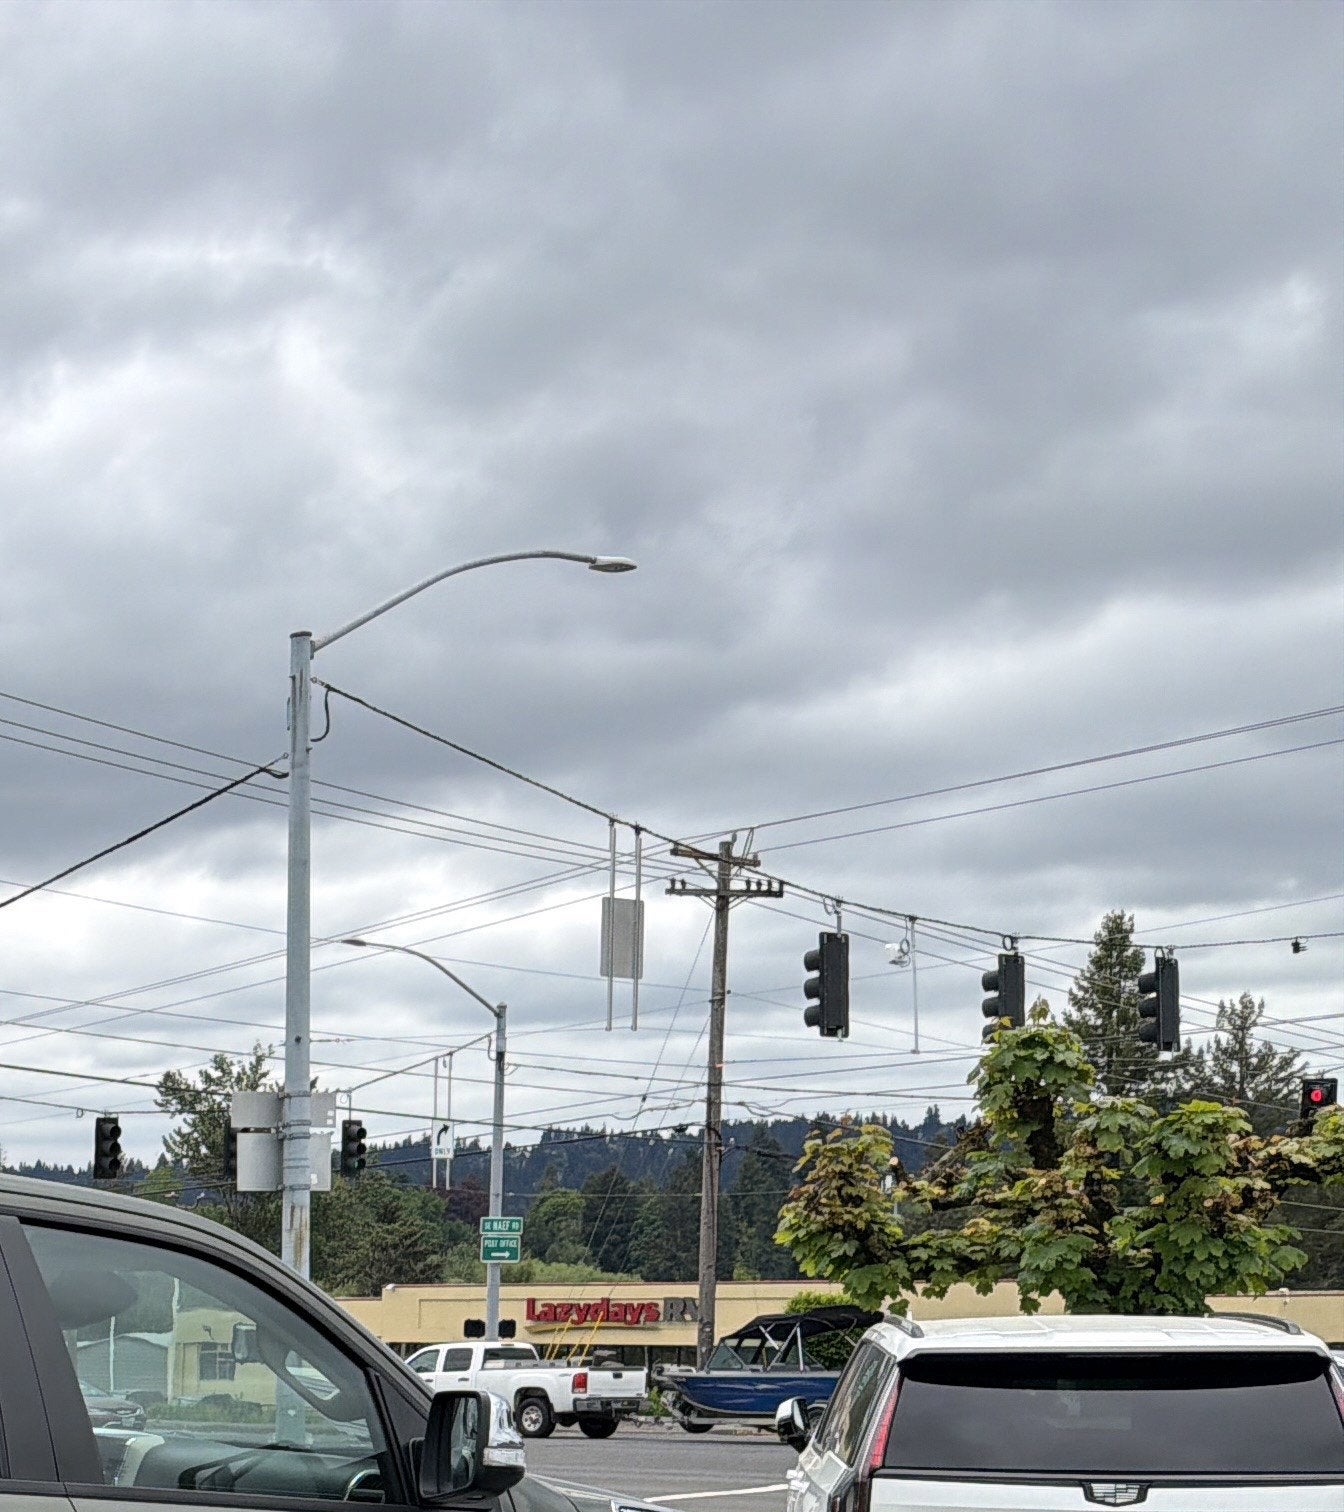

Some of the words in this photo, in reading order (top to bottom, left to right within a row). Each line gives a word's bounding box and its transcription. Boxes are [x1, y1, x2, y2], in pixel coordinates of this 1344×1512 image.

[484, 1239, 498, 1248] POST
[499, 1239, 518, 1248] OFFICE
[526, 1297, 661, 1325] Lazydays
[662, 1297, 699, 1322] RV
